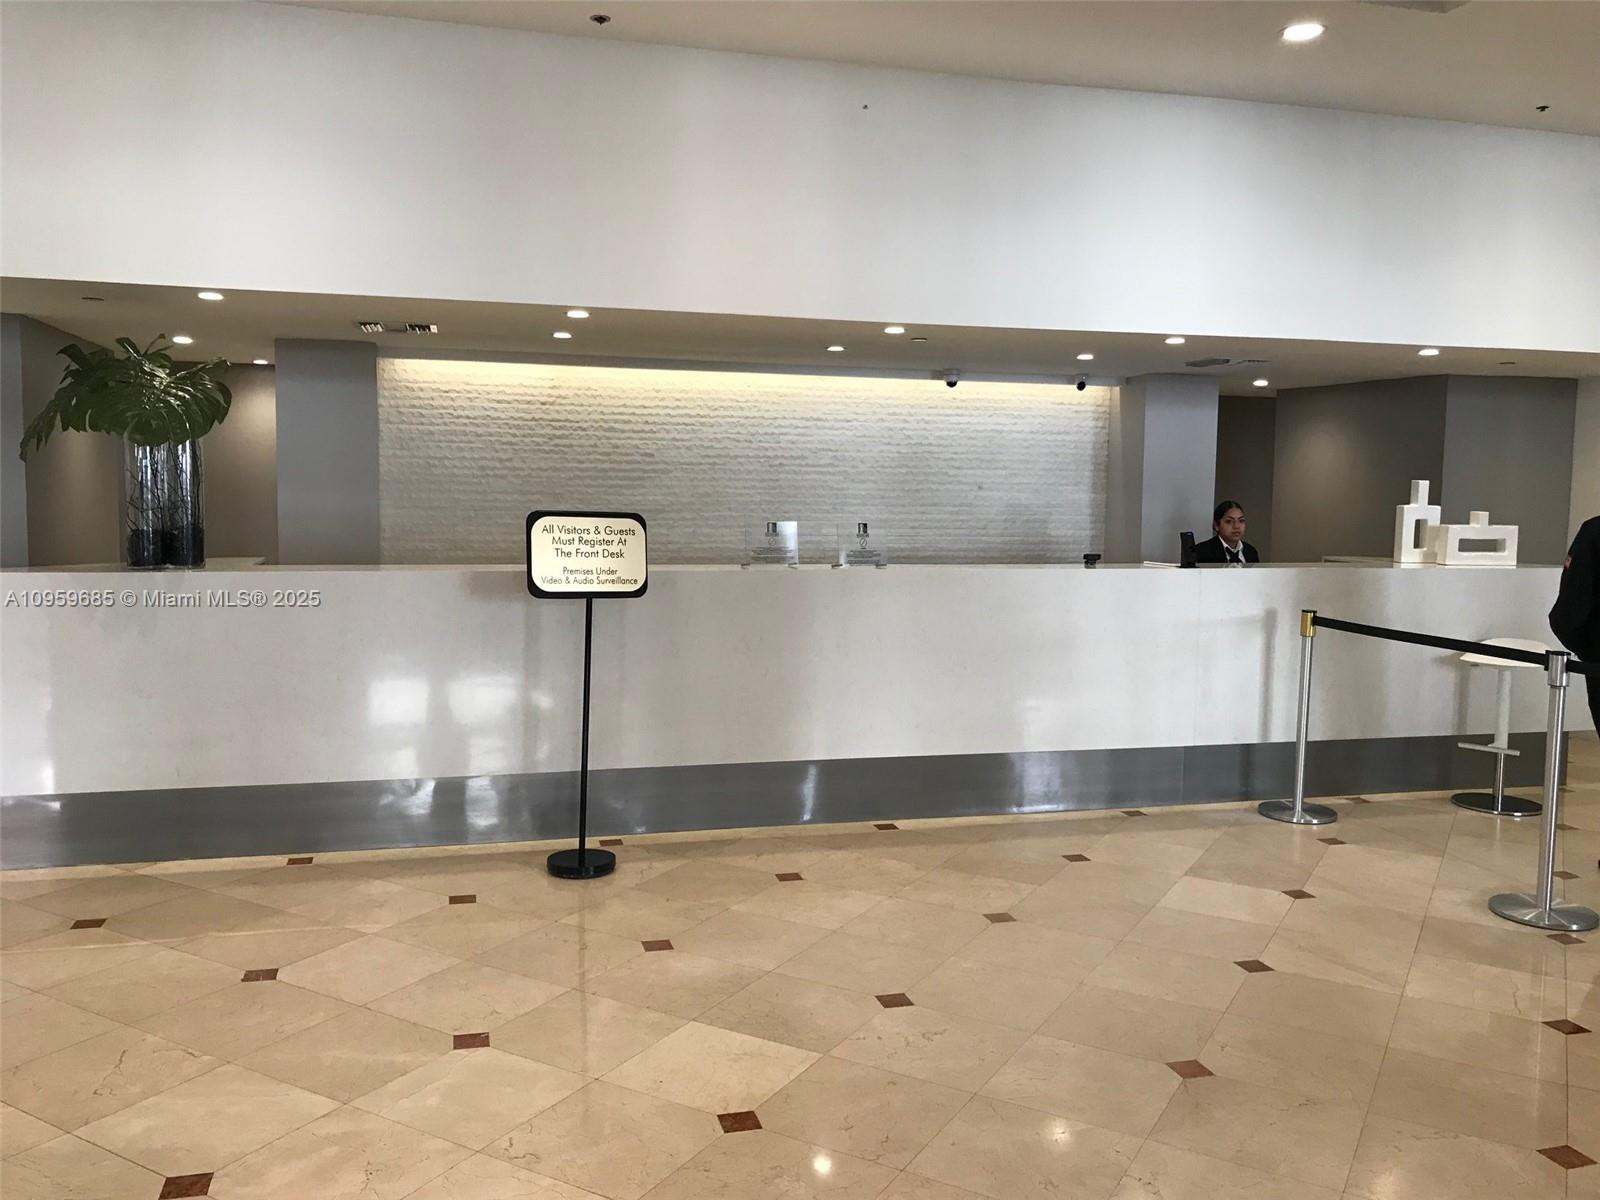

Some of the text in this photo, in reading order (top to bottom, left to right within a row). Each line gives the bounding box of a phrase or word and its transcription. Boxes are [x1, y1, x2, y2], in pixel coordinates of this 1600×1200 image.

[542, 525, 636, 536] All Visitors & Guests
[552, 536, 627, 548] Must Register At
[555, 548, 624, 558] The Front Desk
[562, 567, 618, 576] Premises Under
[541, 576, 638, 585] Video & Audio Surveillance
